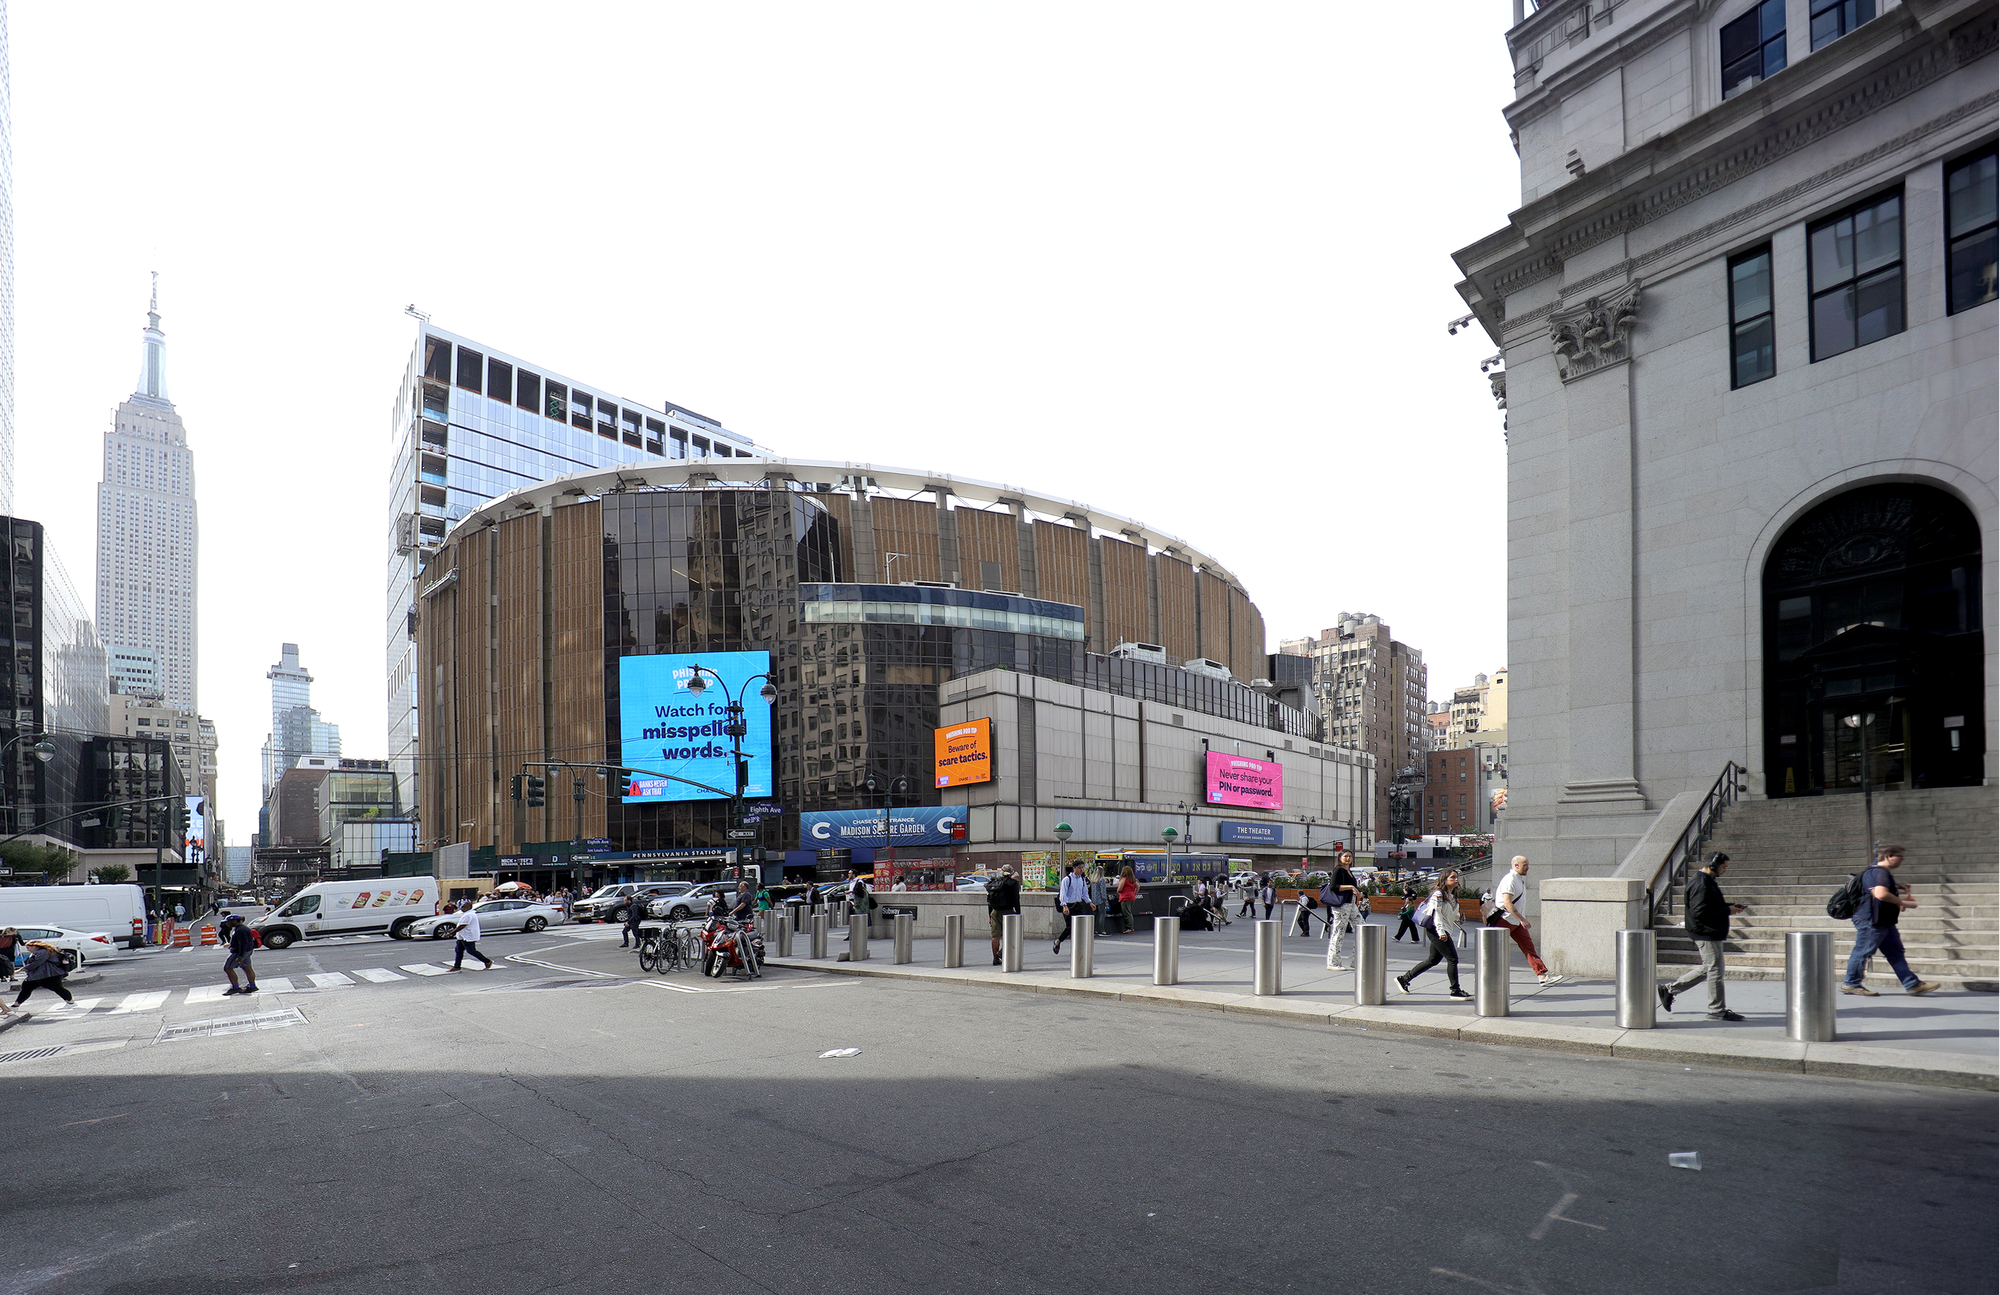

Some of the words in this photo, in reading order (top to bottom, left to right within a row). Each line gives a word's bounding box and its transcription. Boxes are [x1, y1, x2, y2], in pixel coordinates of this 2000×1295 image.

[655, 703, 704, 717] Watch
[643, 719, 747, 742] misspelle
[662, 740, 728, 760] words.
[948, 743, 969, 753] Beware
[970, 740, 977, 750] of
[939, 757, 958, 767] scare
[959, 750, 988, 764] tactics.
[1220, 768, 1239, 780] Never
[1240, 772, 1258, 783] share
[1259, 777, 1272, 786] your
[1219, 781, 1232, 791] PIN
[1241, 786, 1274, 797] password.
[750, 806, 769, 814] Eighth
[841, 826, 870, 836] MADISON
[900, 823, 925, 833] GARDEN
[1237, 826, 1248, 834] THE
[1249, 827, 1271, 835] THEATER
[882, 907, 900, 915] Subway
